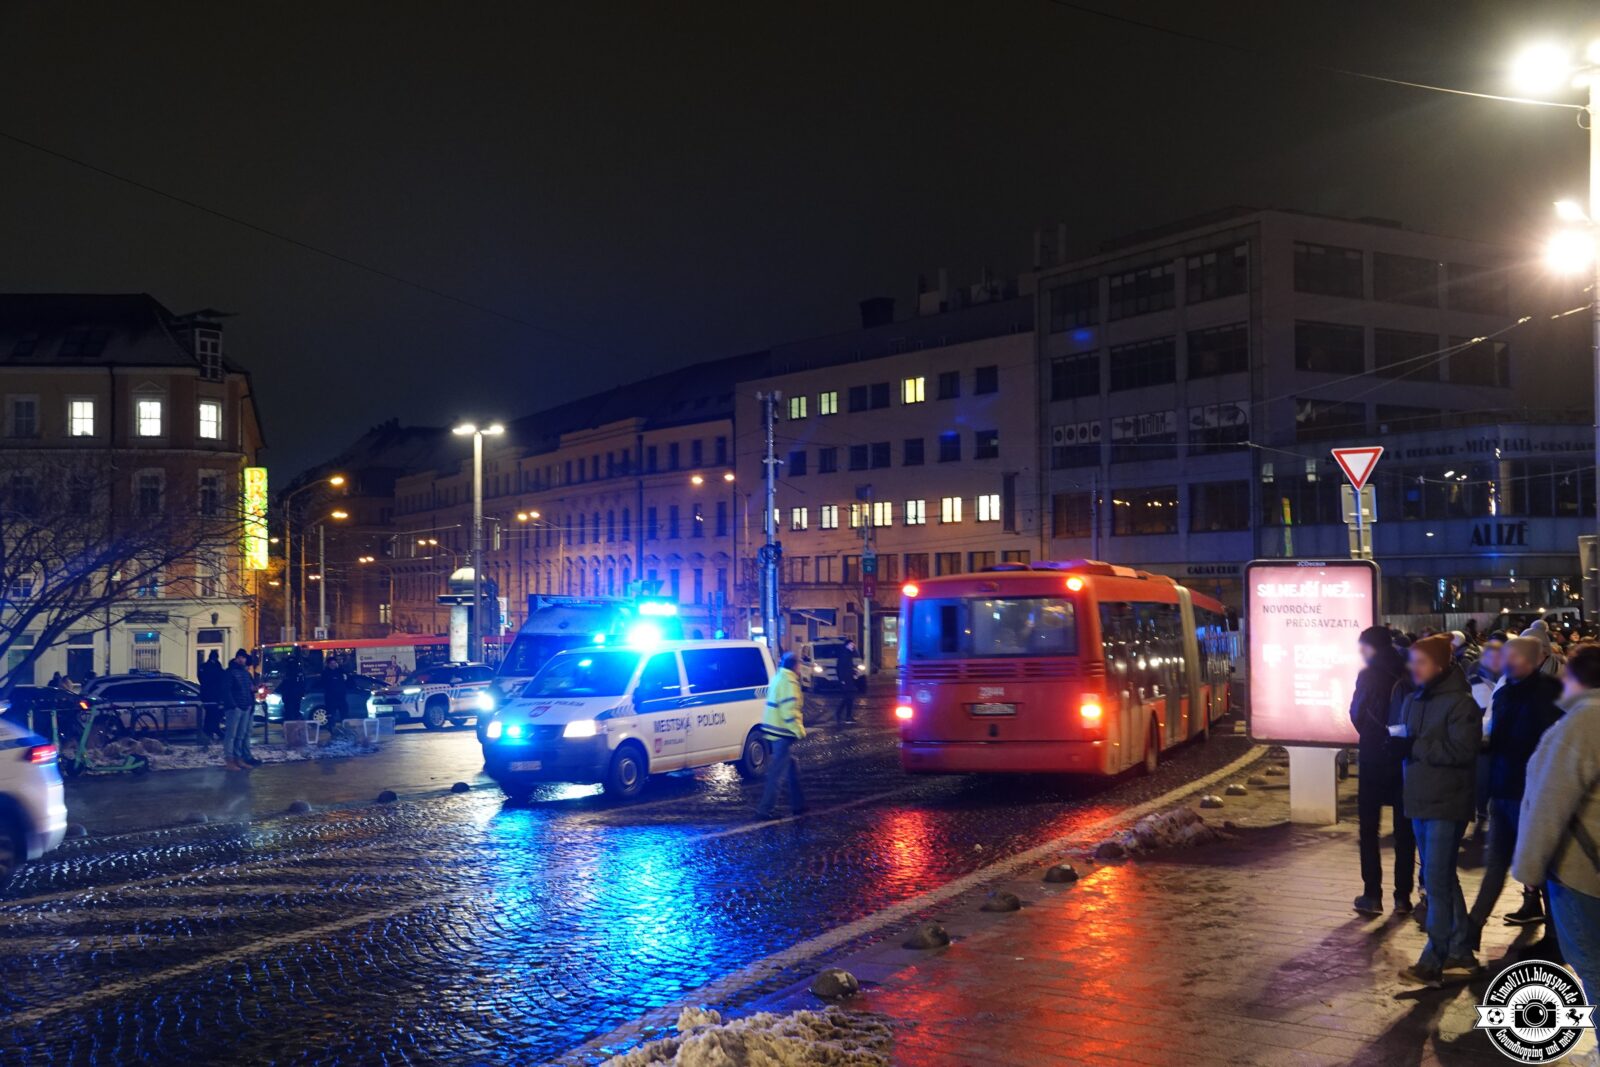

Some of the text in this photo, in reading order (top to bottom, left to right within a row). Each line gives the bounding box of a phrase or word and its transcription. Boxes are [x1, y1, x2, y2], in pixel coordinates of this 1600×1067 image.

[1470, 520, 1529, 546] ALIZÉ
[1256, 580, 1320, 598] SILNEJŠÍ
[1262, 602, 1322, 614] NOVOROČNÉ
[1286, 618, 1360, 629] PREDSAVZATIA
[653, 710, 727, 733] MESTSKÁ POLÍCIA
